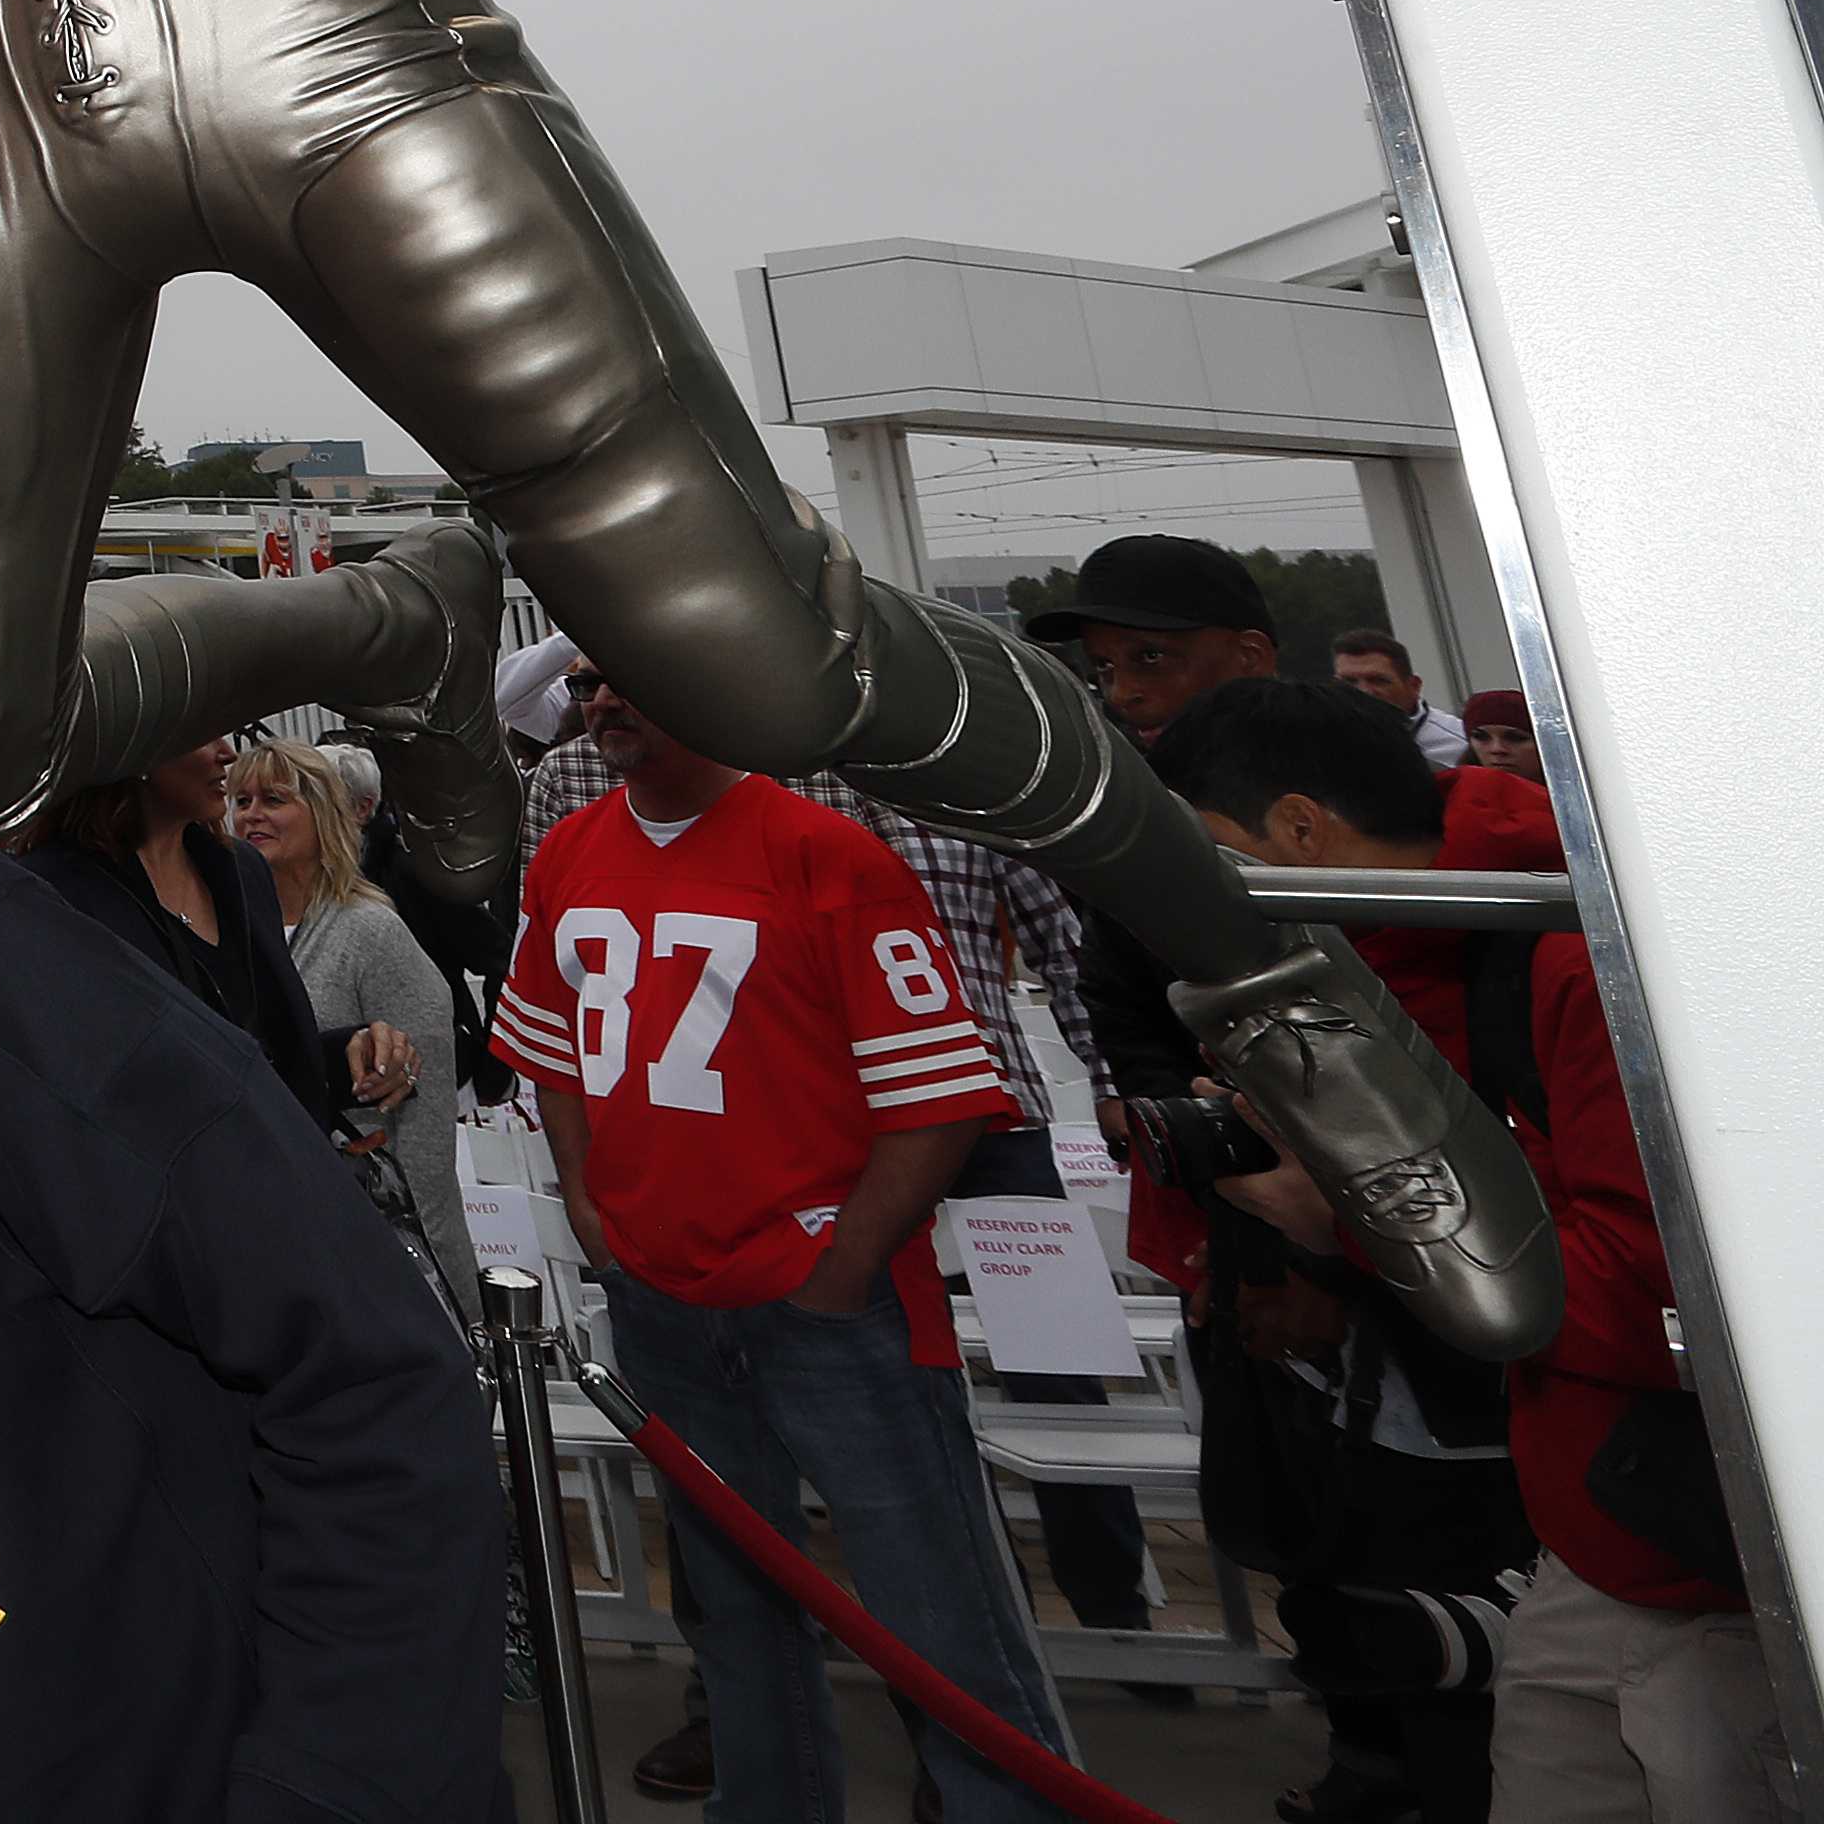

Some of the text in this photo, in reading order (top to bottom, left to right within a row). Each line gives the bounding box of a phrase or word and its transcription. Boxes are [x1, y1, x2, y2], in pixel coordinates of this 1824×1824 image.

[872, 927, 974, 1015] 8
[555, 908, 758, 1114] 87
[465, 1202, 499, 1214] RVED
[966, 1219, 1073, 1234] RESERVED FOR
[973, 1240, 1065, 1256] KELLY CLARK
[980, 1263, 1032, 1276] GROUP
